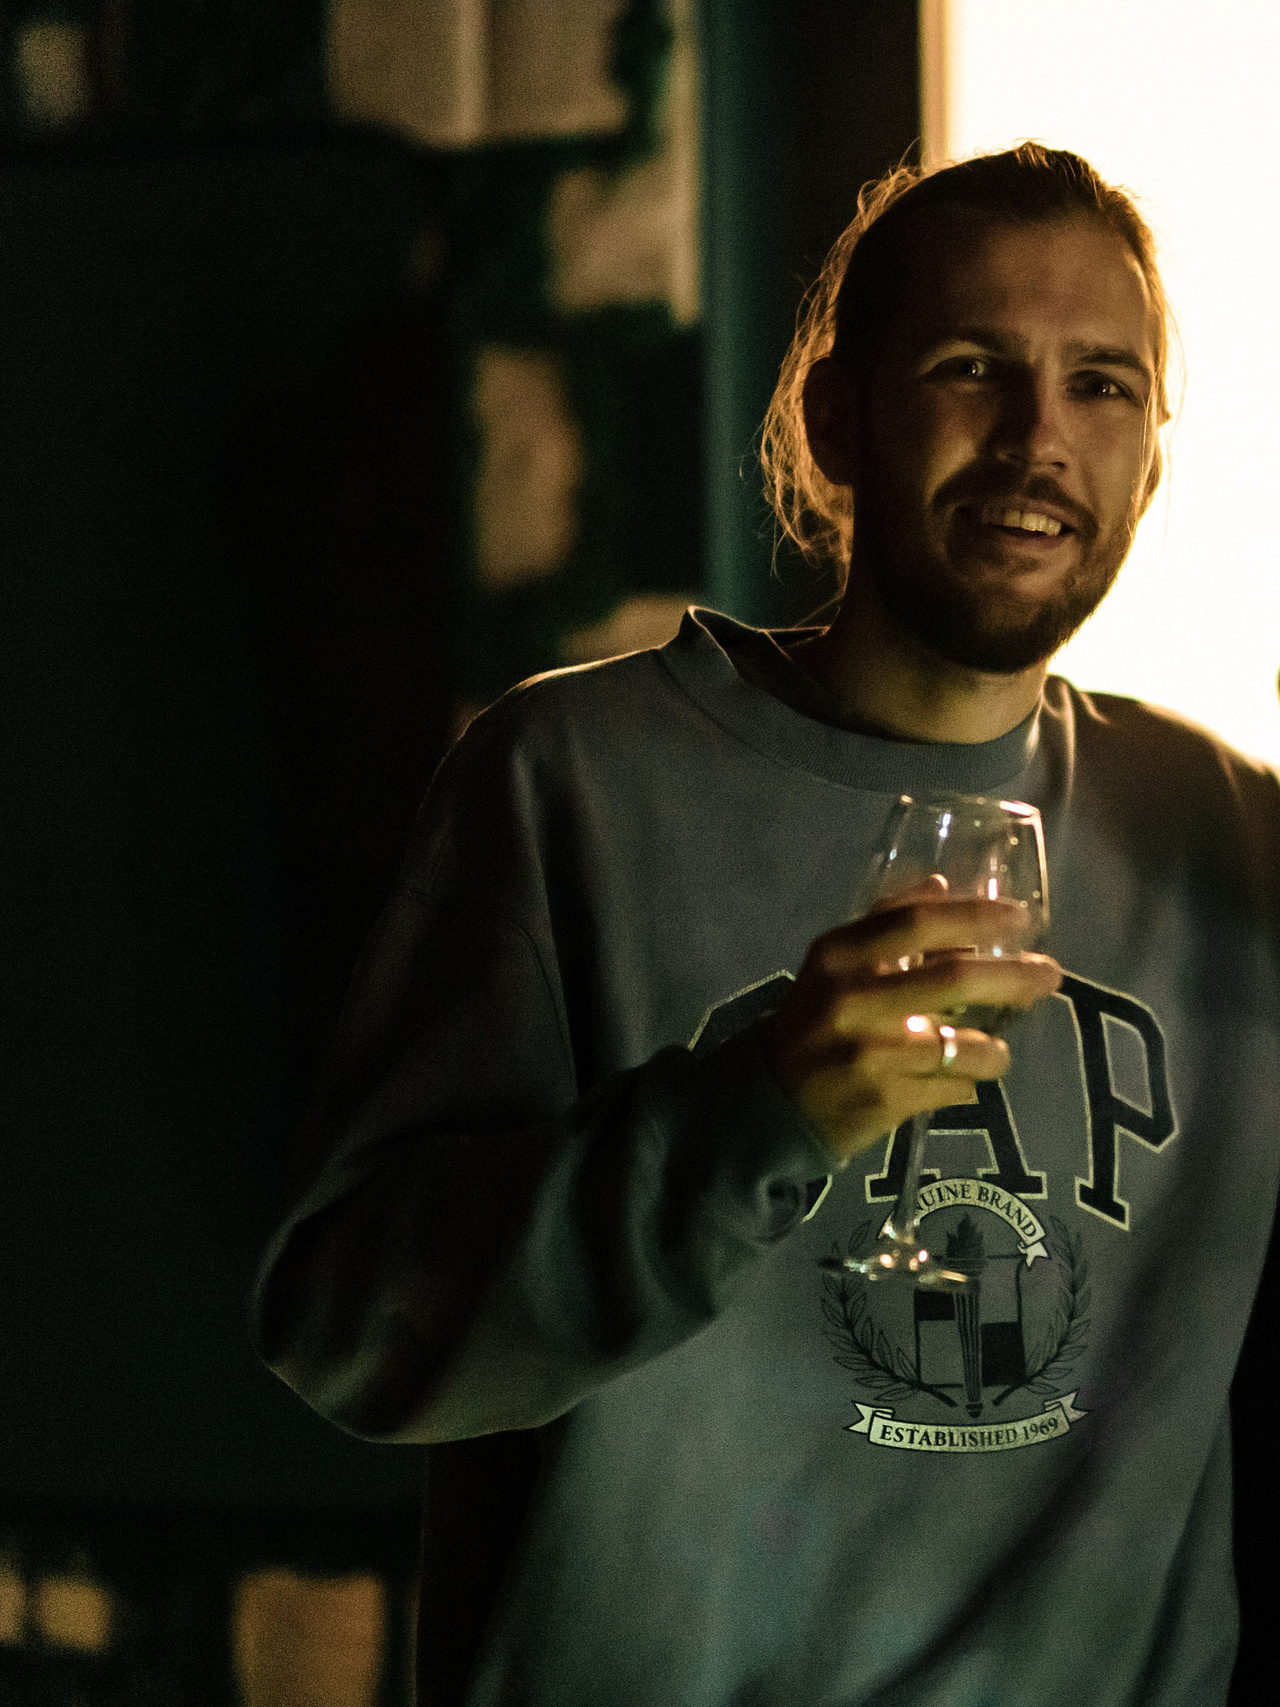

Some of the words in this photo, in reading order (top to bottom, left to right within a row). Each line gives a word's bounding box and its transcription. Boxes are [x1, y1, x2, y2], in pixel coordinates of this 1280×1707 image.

[687, 968, 1179, 1231] AP
[914, 1183, 972, 1212] UINE
[977, 1186, 1037, 1237] BRAND
[880, 1423, 1017, 1448] ESTABLISHED
[1022, 1417, 1058, 1440] 1969
